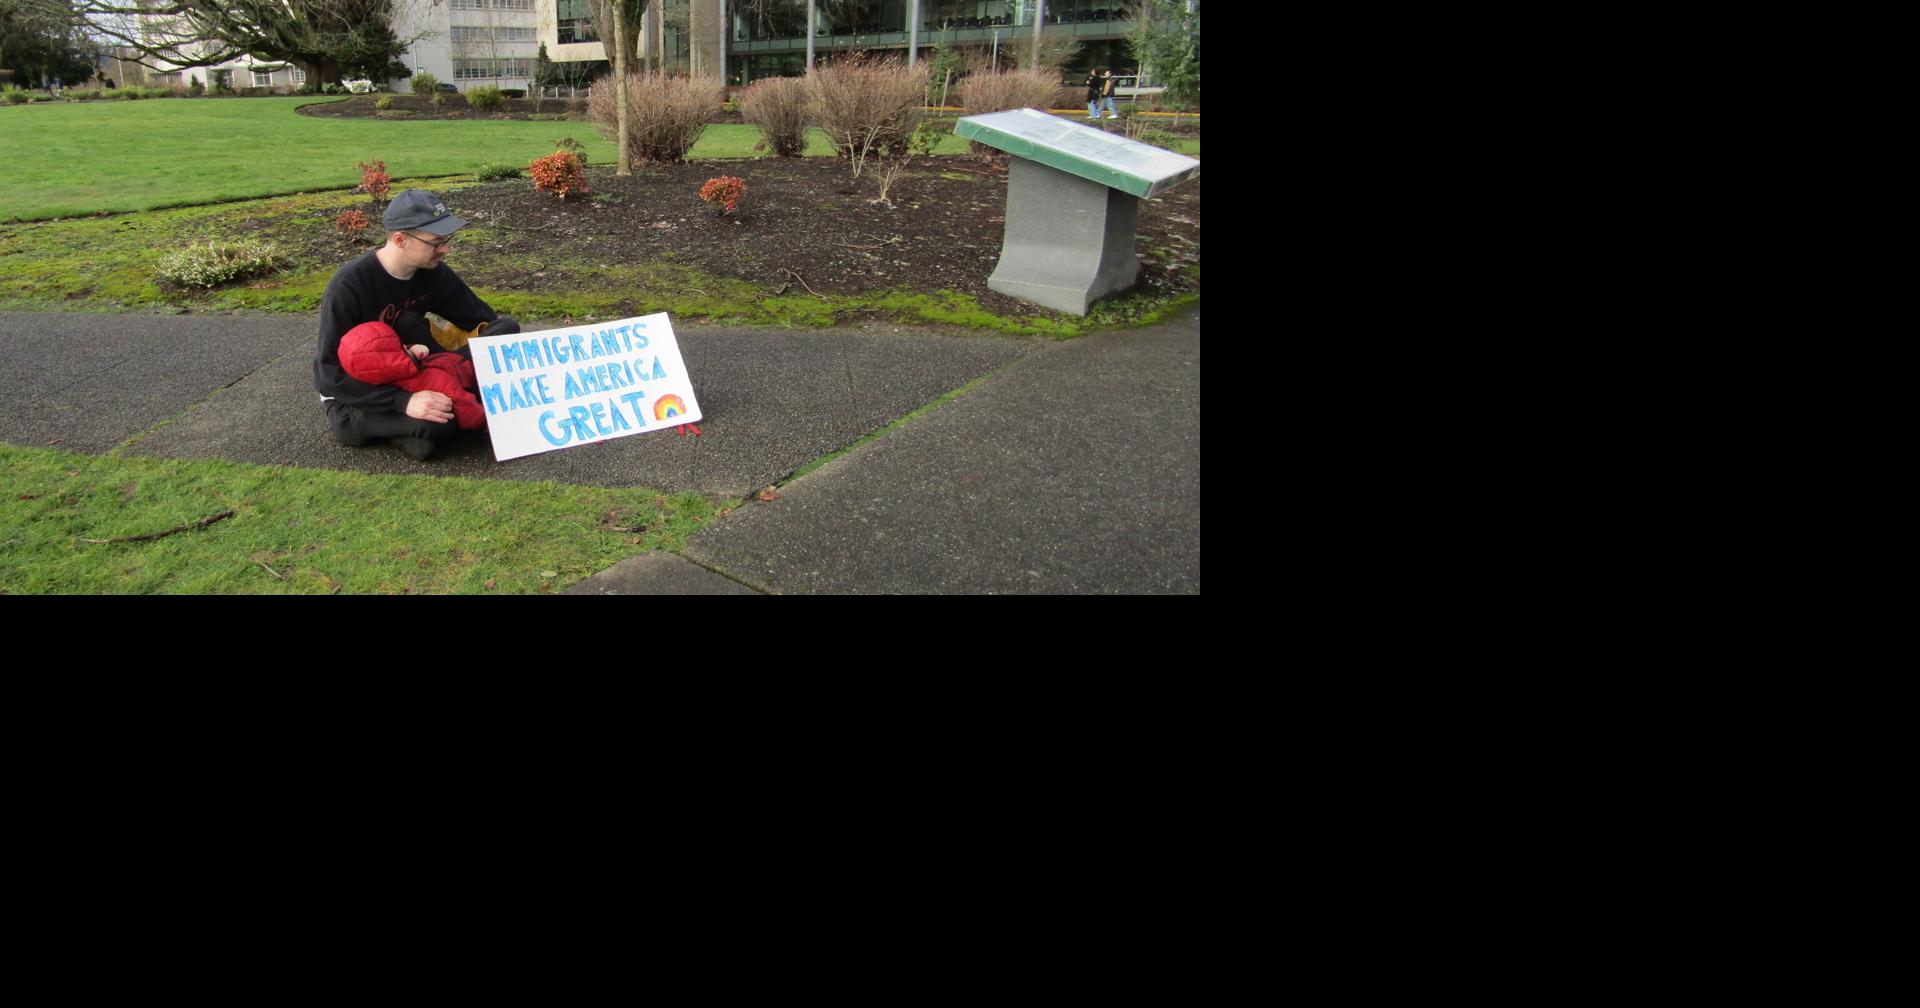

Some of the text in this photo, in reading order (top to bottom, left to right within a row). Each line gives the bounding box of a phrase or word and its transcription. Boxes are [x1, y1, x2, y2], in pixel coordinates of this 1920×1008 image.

[488, 324, 650, 374] IMMIGRANTS
[482, 356, 667, 415] MAKE AMERICA
[538, 392, 647, 446] GREAT
